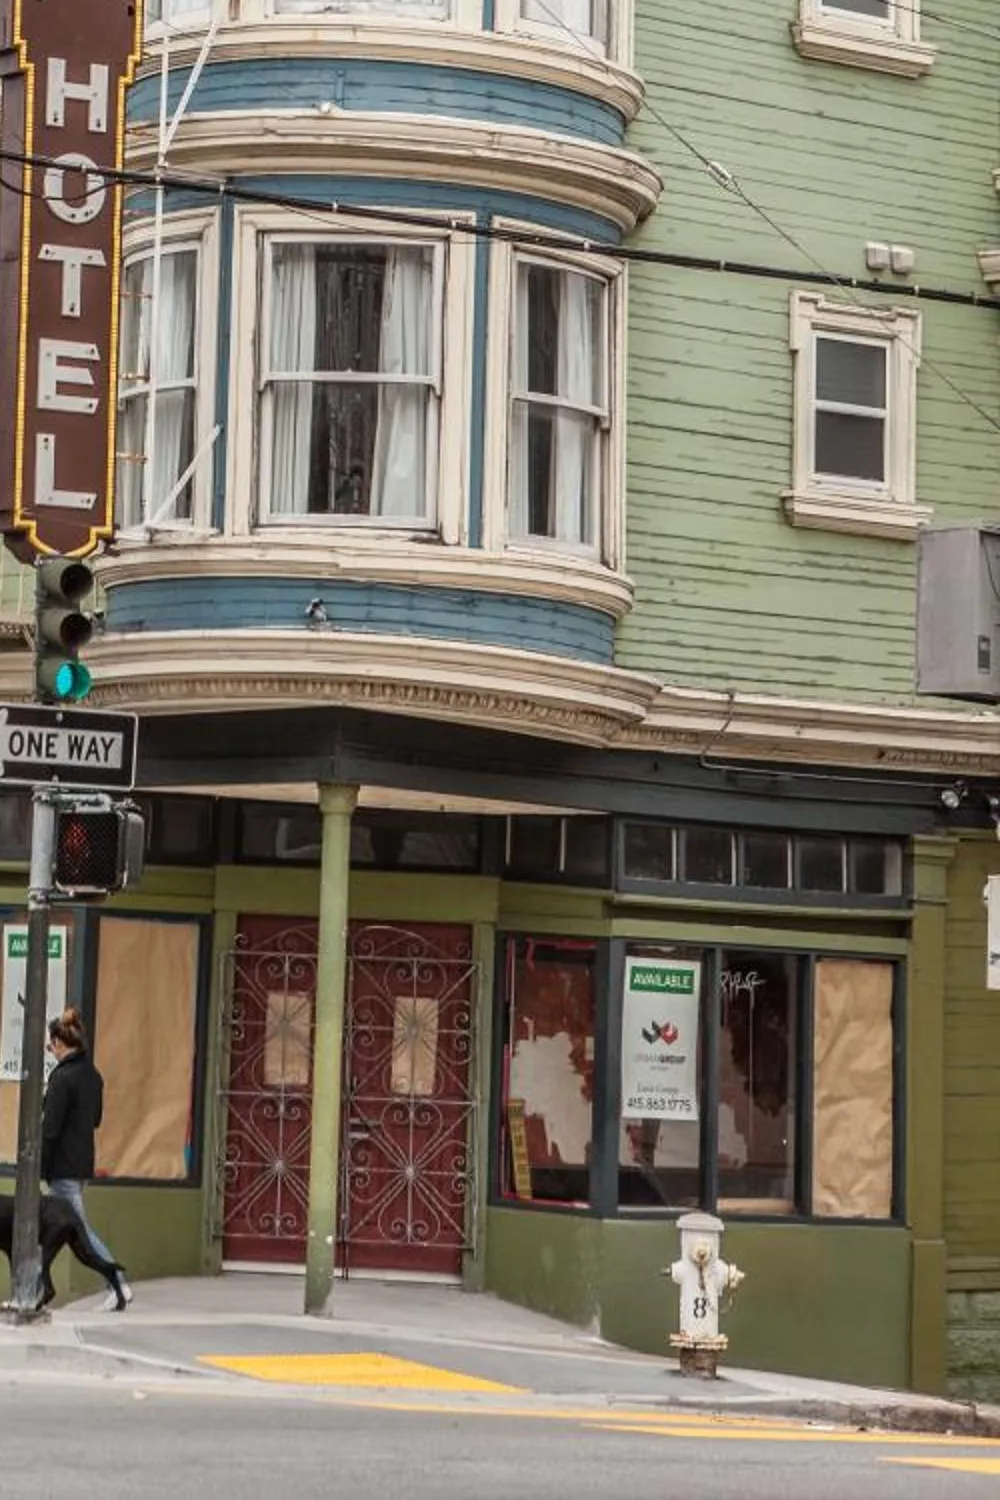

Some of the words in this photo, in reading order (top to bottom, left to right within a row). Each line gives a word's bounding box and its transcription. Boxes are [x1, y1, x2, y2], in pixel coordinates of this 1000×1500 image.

[34, 56, 109, 510] HOTEL
[8, 730, 58, 759] ONE
[67, 735, 114, 763] WAY
[634, 973, 690, 988] AVAILABLE
[693, 1297, 707, 1319] 8
